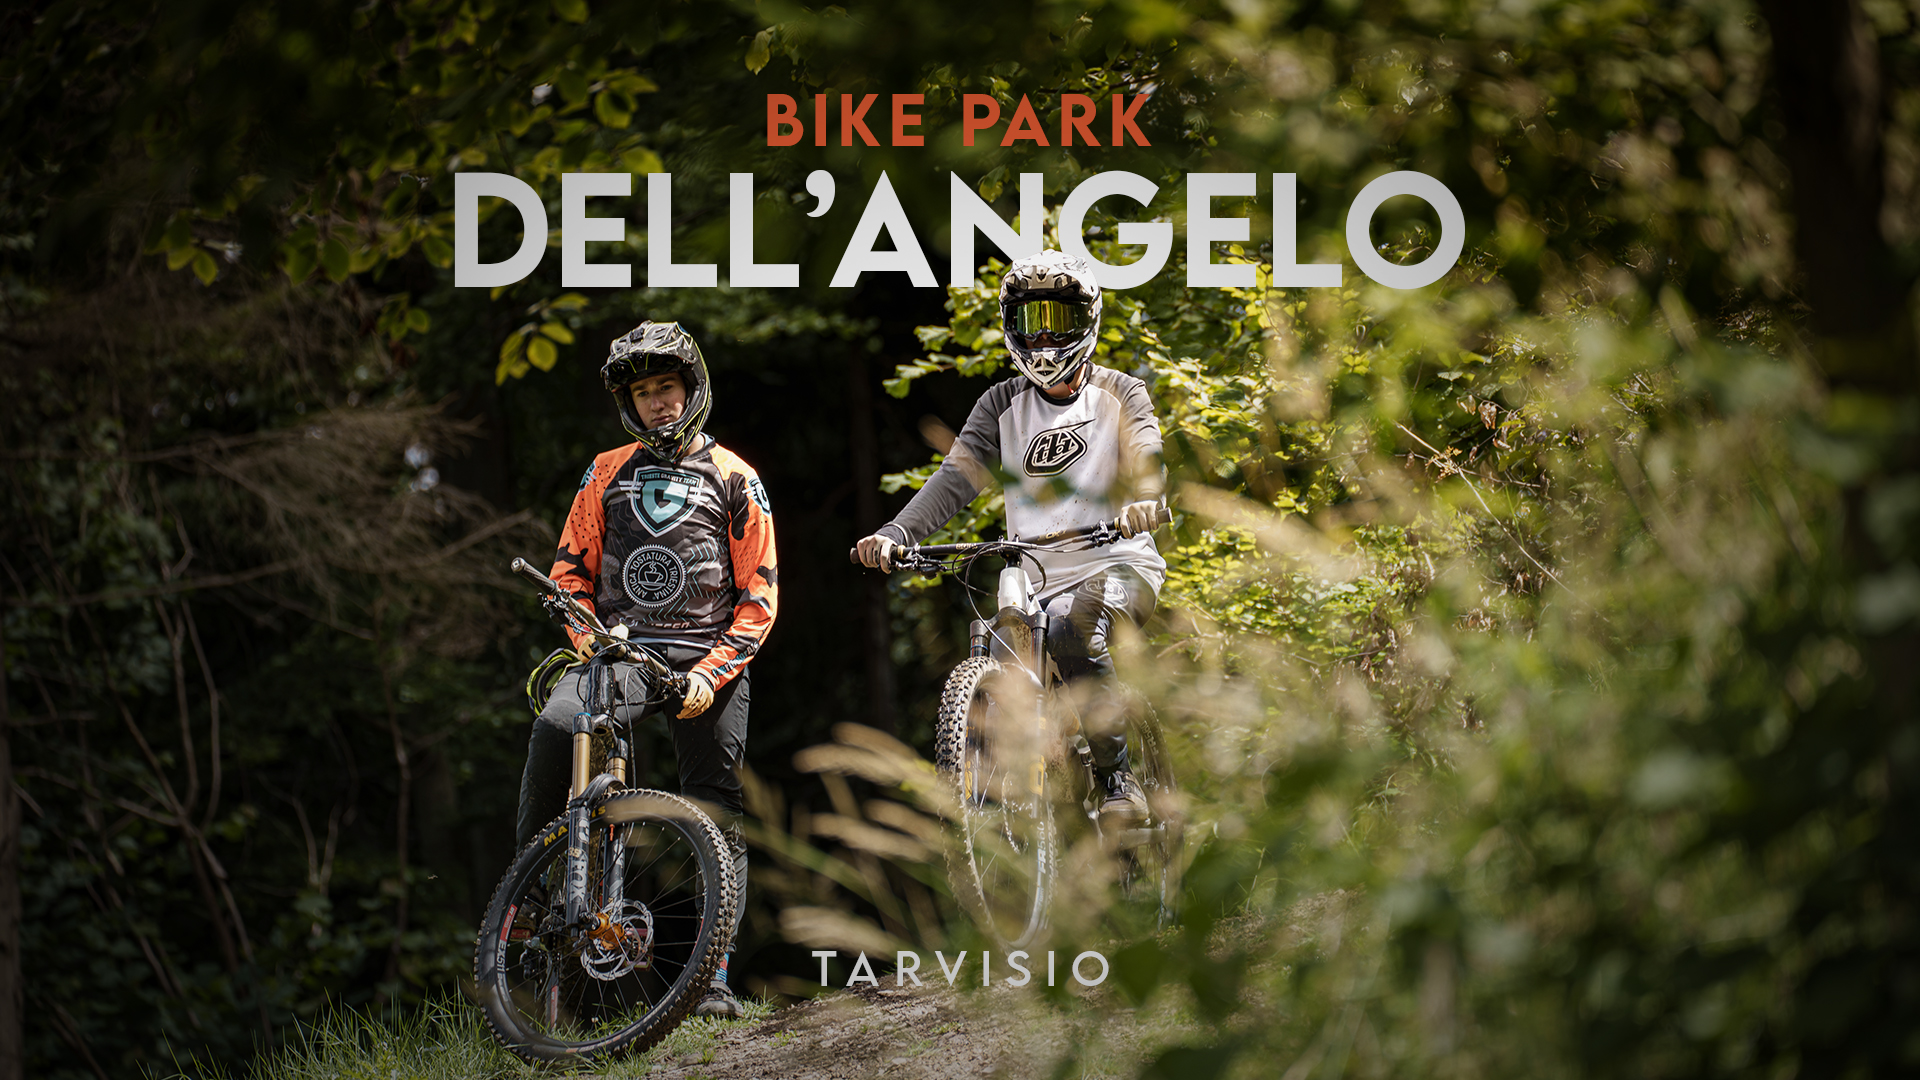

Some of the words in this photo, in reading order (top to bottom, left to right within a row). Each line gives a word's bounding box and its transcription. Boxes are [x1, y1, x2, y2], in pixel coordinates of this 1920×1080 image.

[683, 476, 697, 486] TEAM
[630, 551, 672, 571] TOSTATURA
[629, 572, 648, 599] ANTICA
[653, 565, 679, 600] TRIESTINA
[543, 805, 606, 847] MAIS
[567, 858, 588, 904] FOX
[496, 941, 507, 975] EX511
